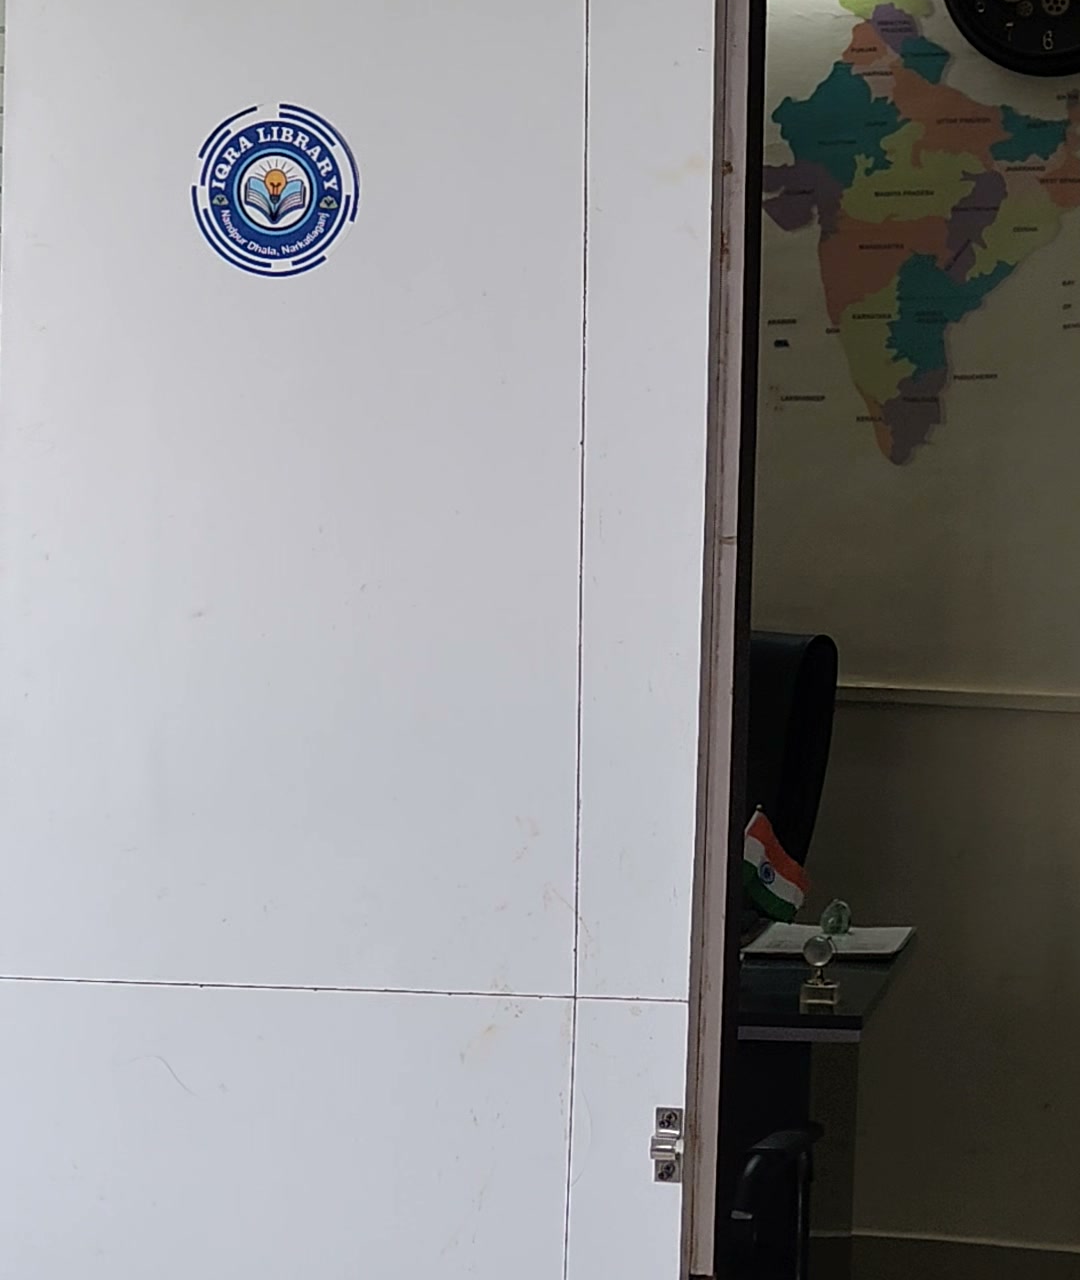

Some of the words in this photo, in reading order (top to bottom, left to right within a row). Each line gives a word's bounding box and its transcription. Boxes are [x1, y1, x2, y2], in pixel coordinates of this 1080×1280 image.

[1042, 30, 1053, 50] 6
[211, 135, 254, 191] IQRA
[256, 126, 339, 191] LIBRARY
[220, 209, 249, 247] Nandpur
[246, 240, 280, 256] Dhala,
[281, 212, 331, 256] Narkatiaganj
